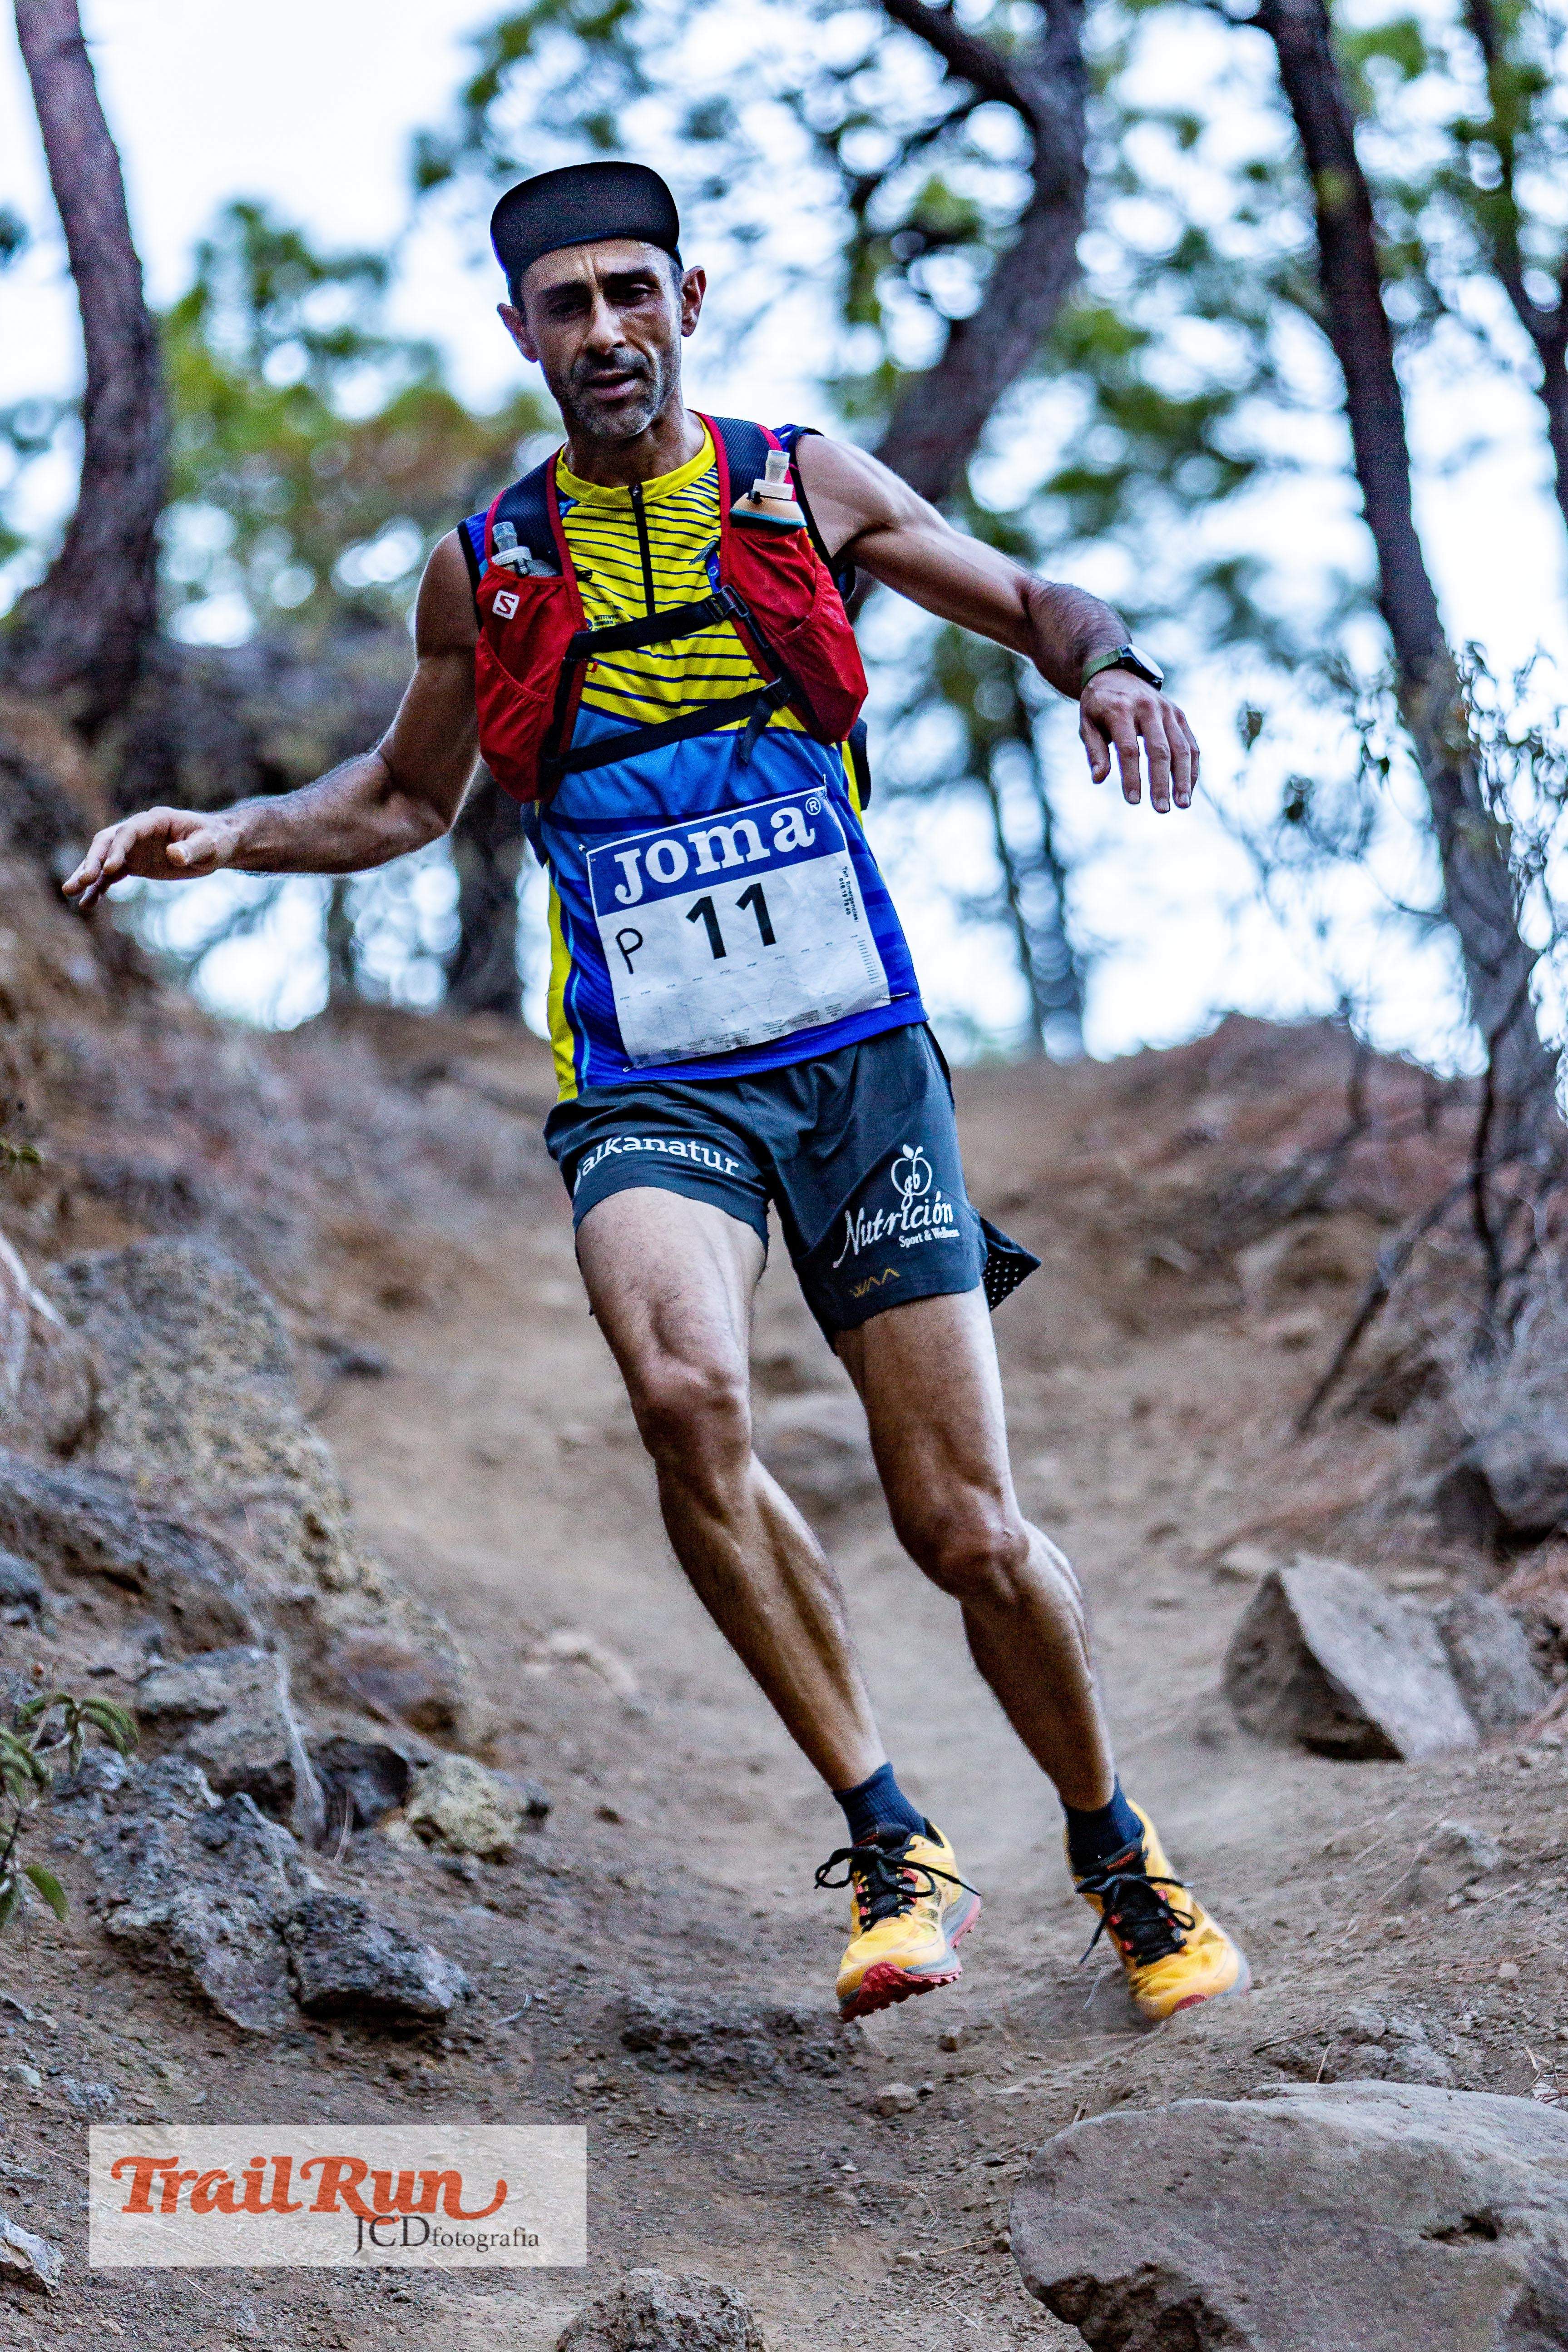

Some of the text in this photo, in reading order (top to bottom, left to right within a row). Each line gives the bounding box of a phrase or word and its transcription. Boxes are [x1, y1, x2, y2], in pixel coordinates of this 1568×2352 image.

[615, 927, 643, 974] P
[685, 882, 777, 960] 11
[832, 1191, 954, 1268] Nutrición
[898, 1232, 923, 1248] Sport
[924, 1229, 932, 1241] &
